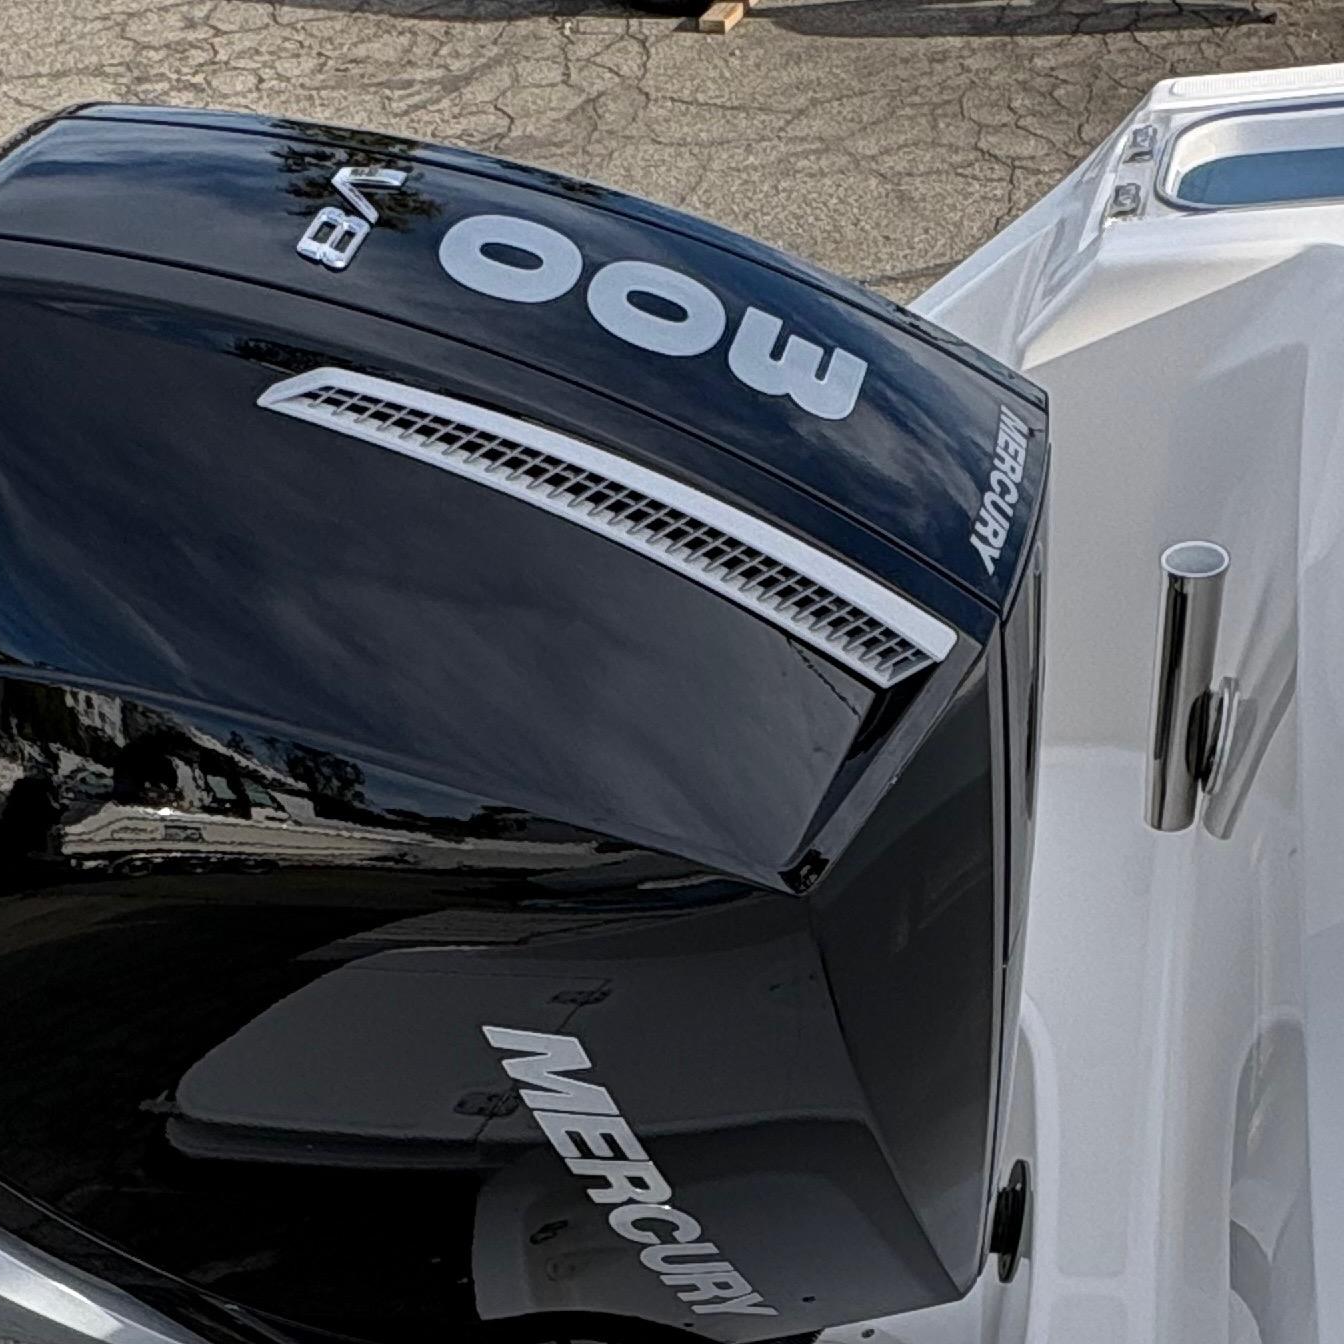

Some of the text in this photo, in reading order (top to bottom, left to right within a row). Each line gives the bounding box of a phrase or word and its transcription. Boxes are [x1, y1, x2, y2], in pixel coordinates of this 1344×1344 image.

[297, 167, 407, 268] V8
[439, 214, 868, 420] 300
[970, 404, 1029, 576] MERCURY
[482, 1025, 779, 1316] MERCURY
